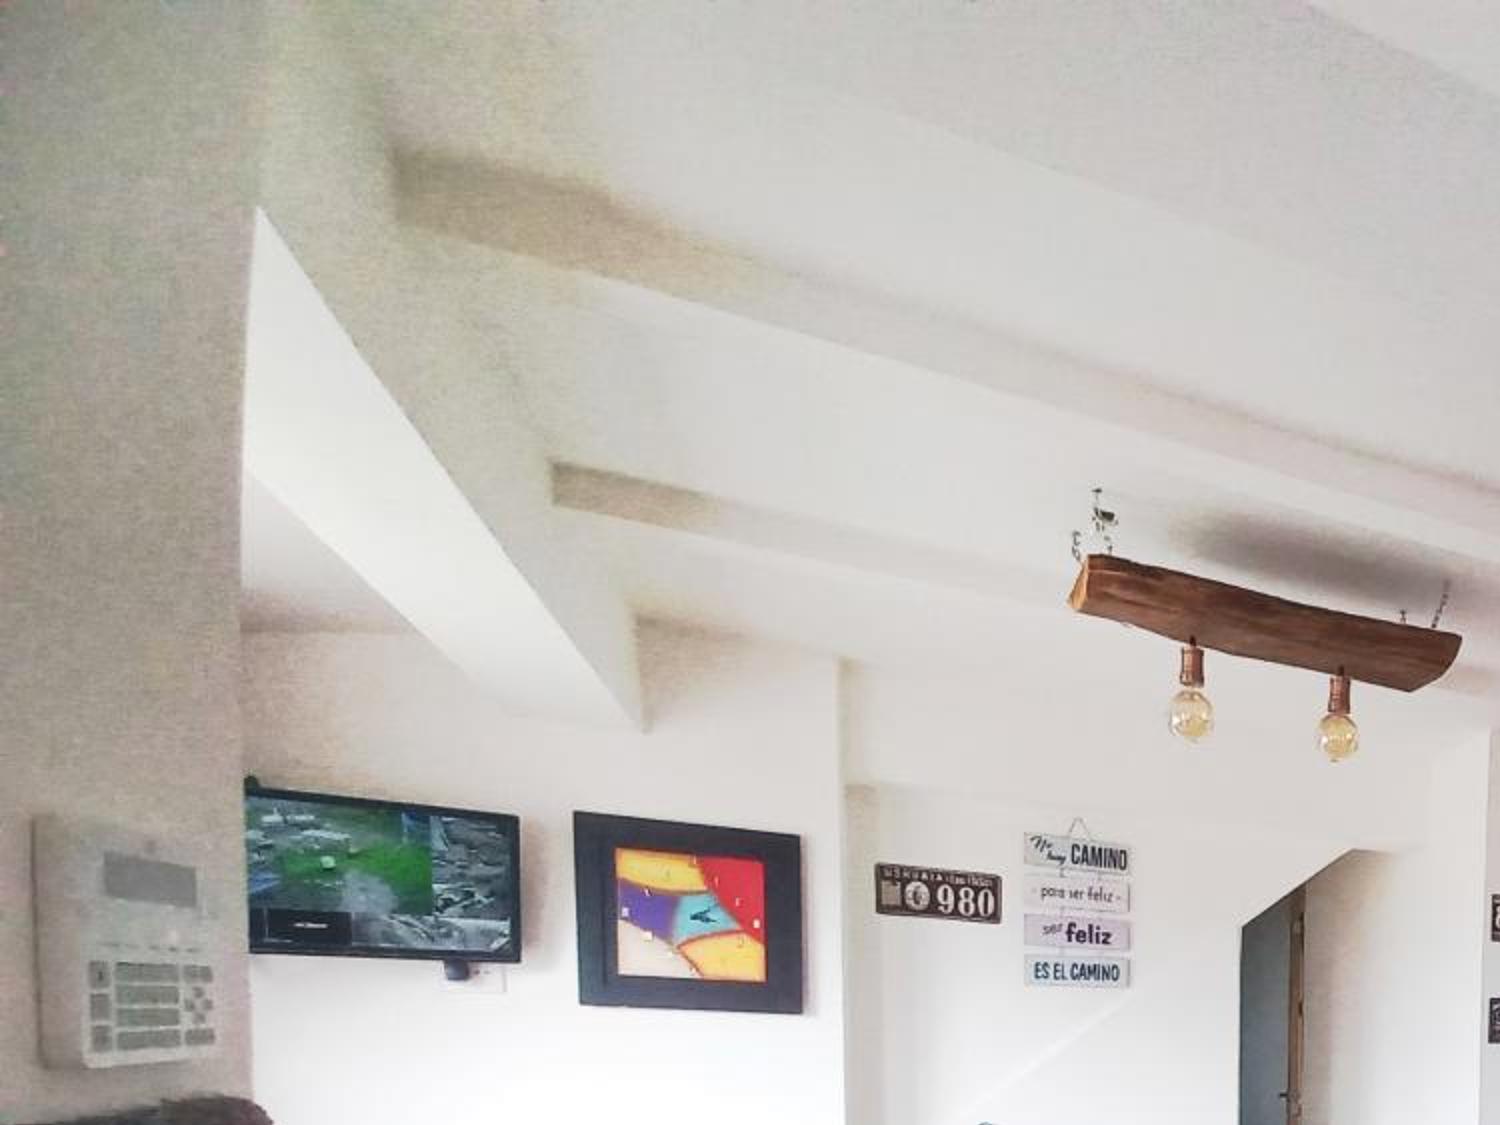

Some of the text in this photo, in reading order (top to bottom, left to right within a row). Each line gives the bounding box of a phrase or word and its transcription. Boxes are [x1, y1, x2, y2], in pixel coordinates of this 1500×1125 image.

[1071, 843, 1127, 871] CAMINO
[1041, 886, 1113, 902] para ser feliz
[1065, 921, 1113, 945] feliz
[1034, 961, 1120, 981] ES EL CAMINO
